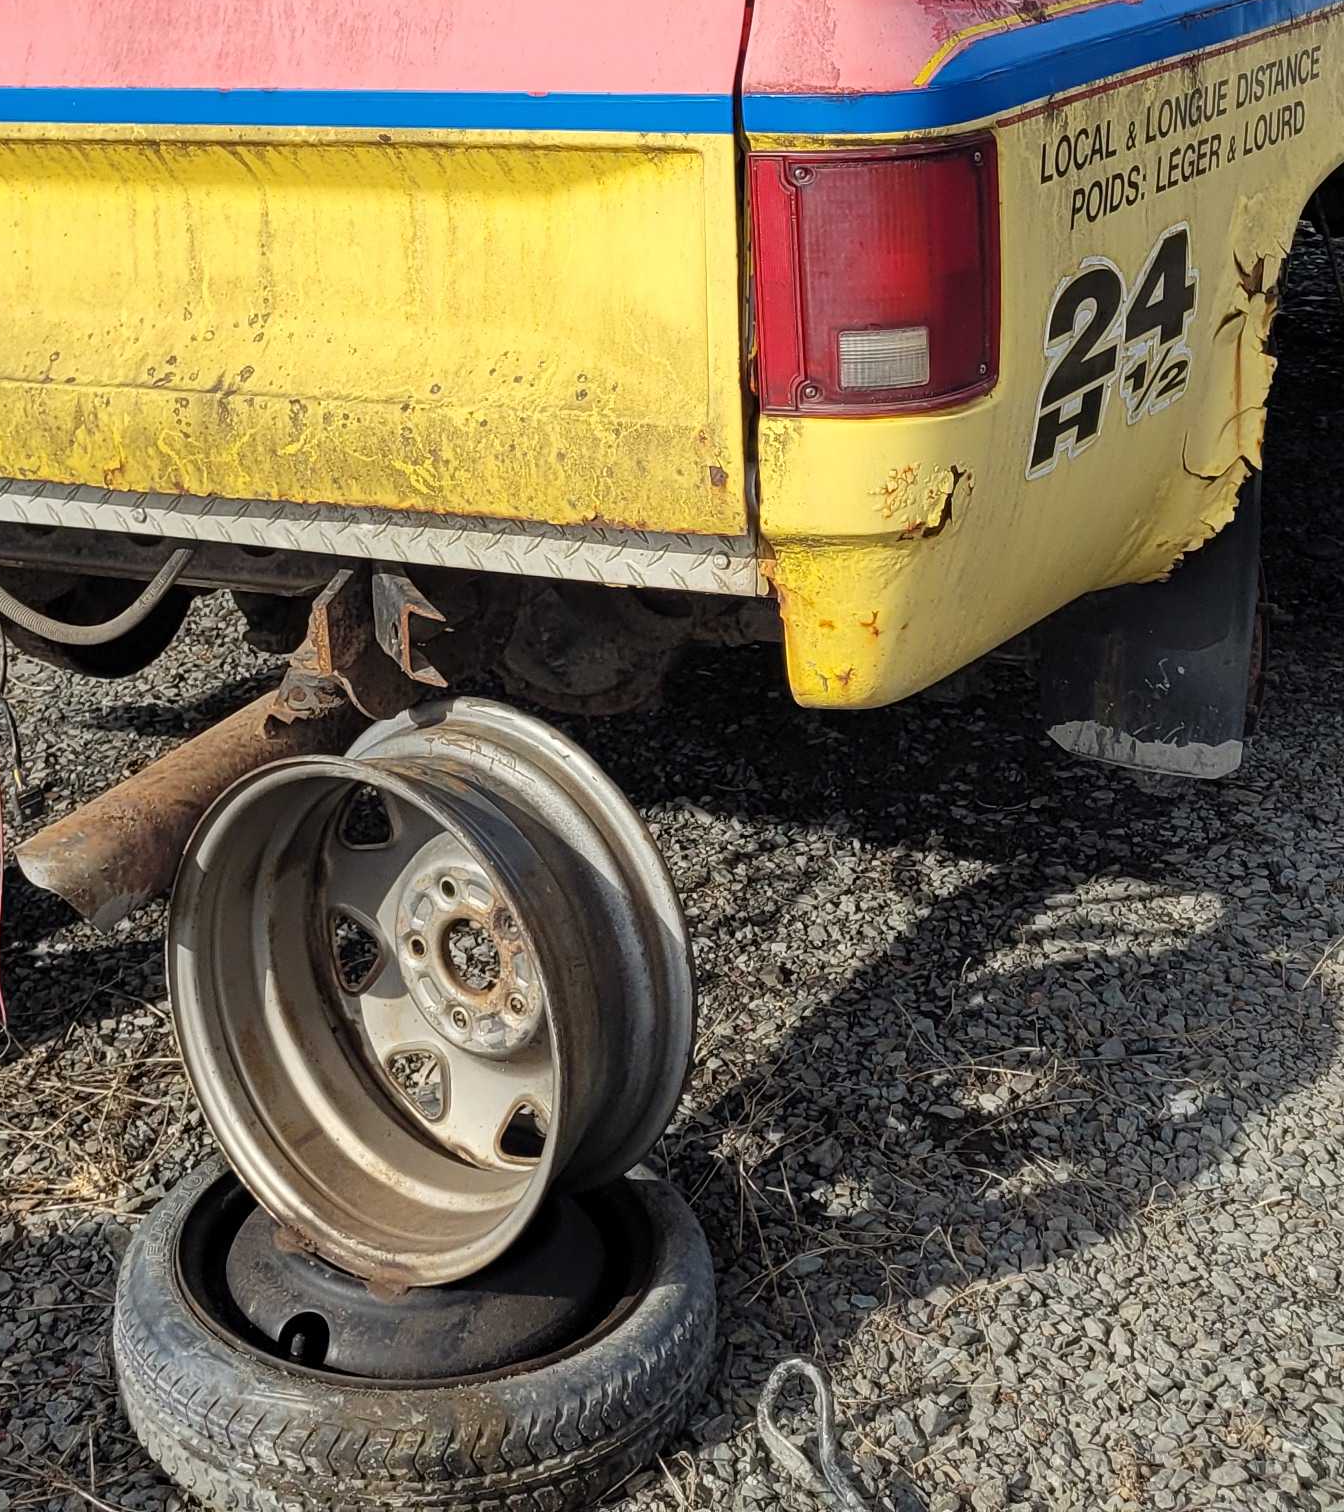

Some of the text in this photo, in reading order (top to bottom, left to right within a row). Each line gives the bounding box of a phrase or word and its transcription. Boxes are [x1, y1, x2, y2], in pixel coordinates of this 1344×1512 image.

[1039, 44, 1322, 185] LOCAL & LONGUE DISTANCE
[1069, 164, 1147, 231] POIDS:
[1226, 134, 1237, 165] &
[1242, 100, 1306, 157] LOURD
[1043, 226, 1197, 410] 24
[1030, 343, 1190, 470] H 1/2
